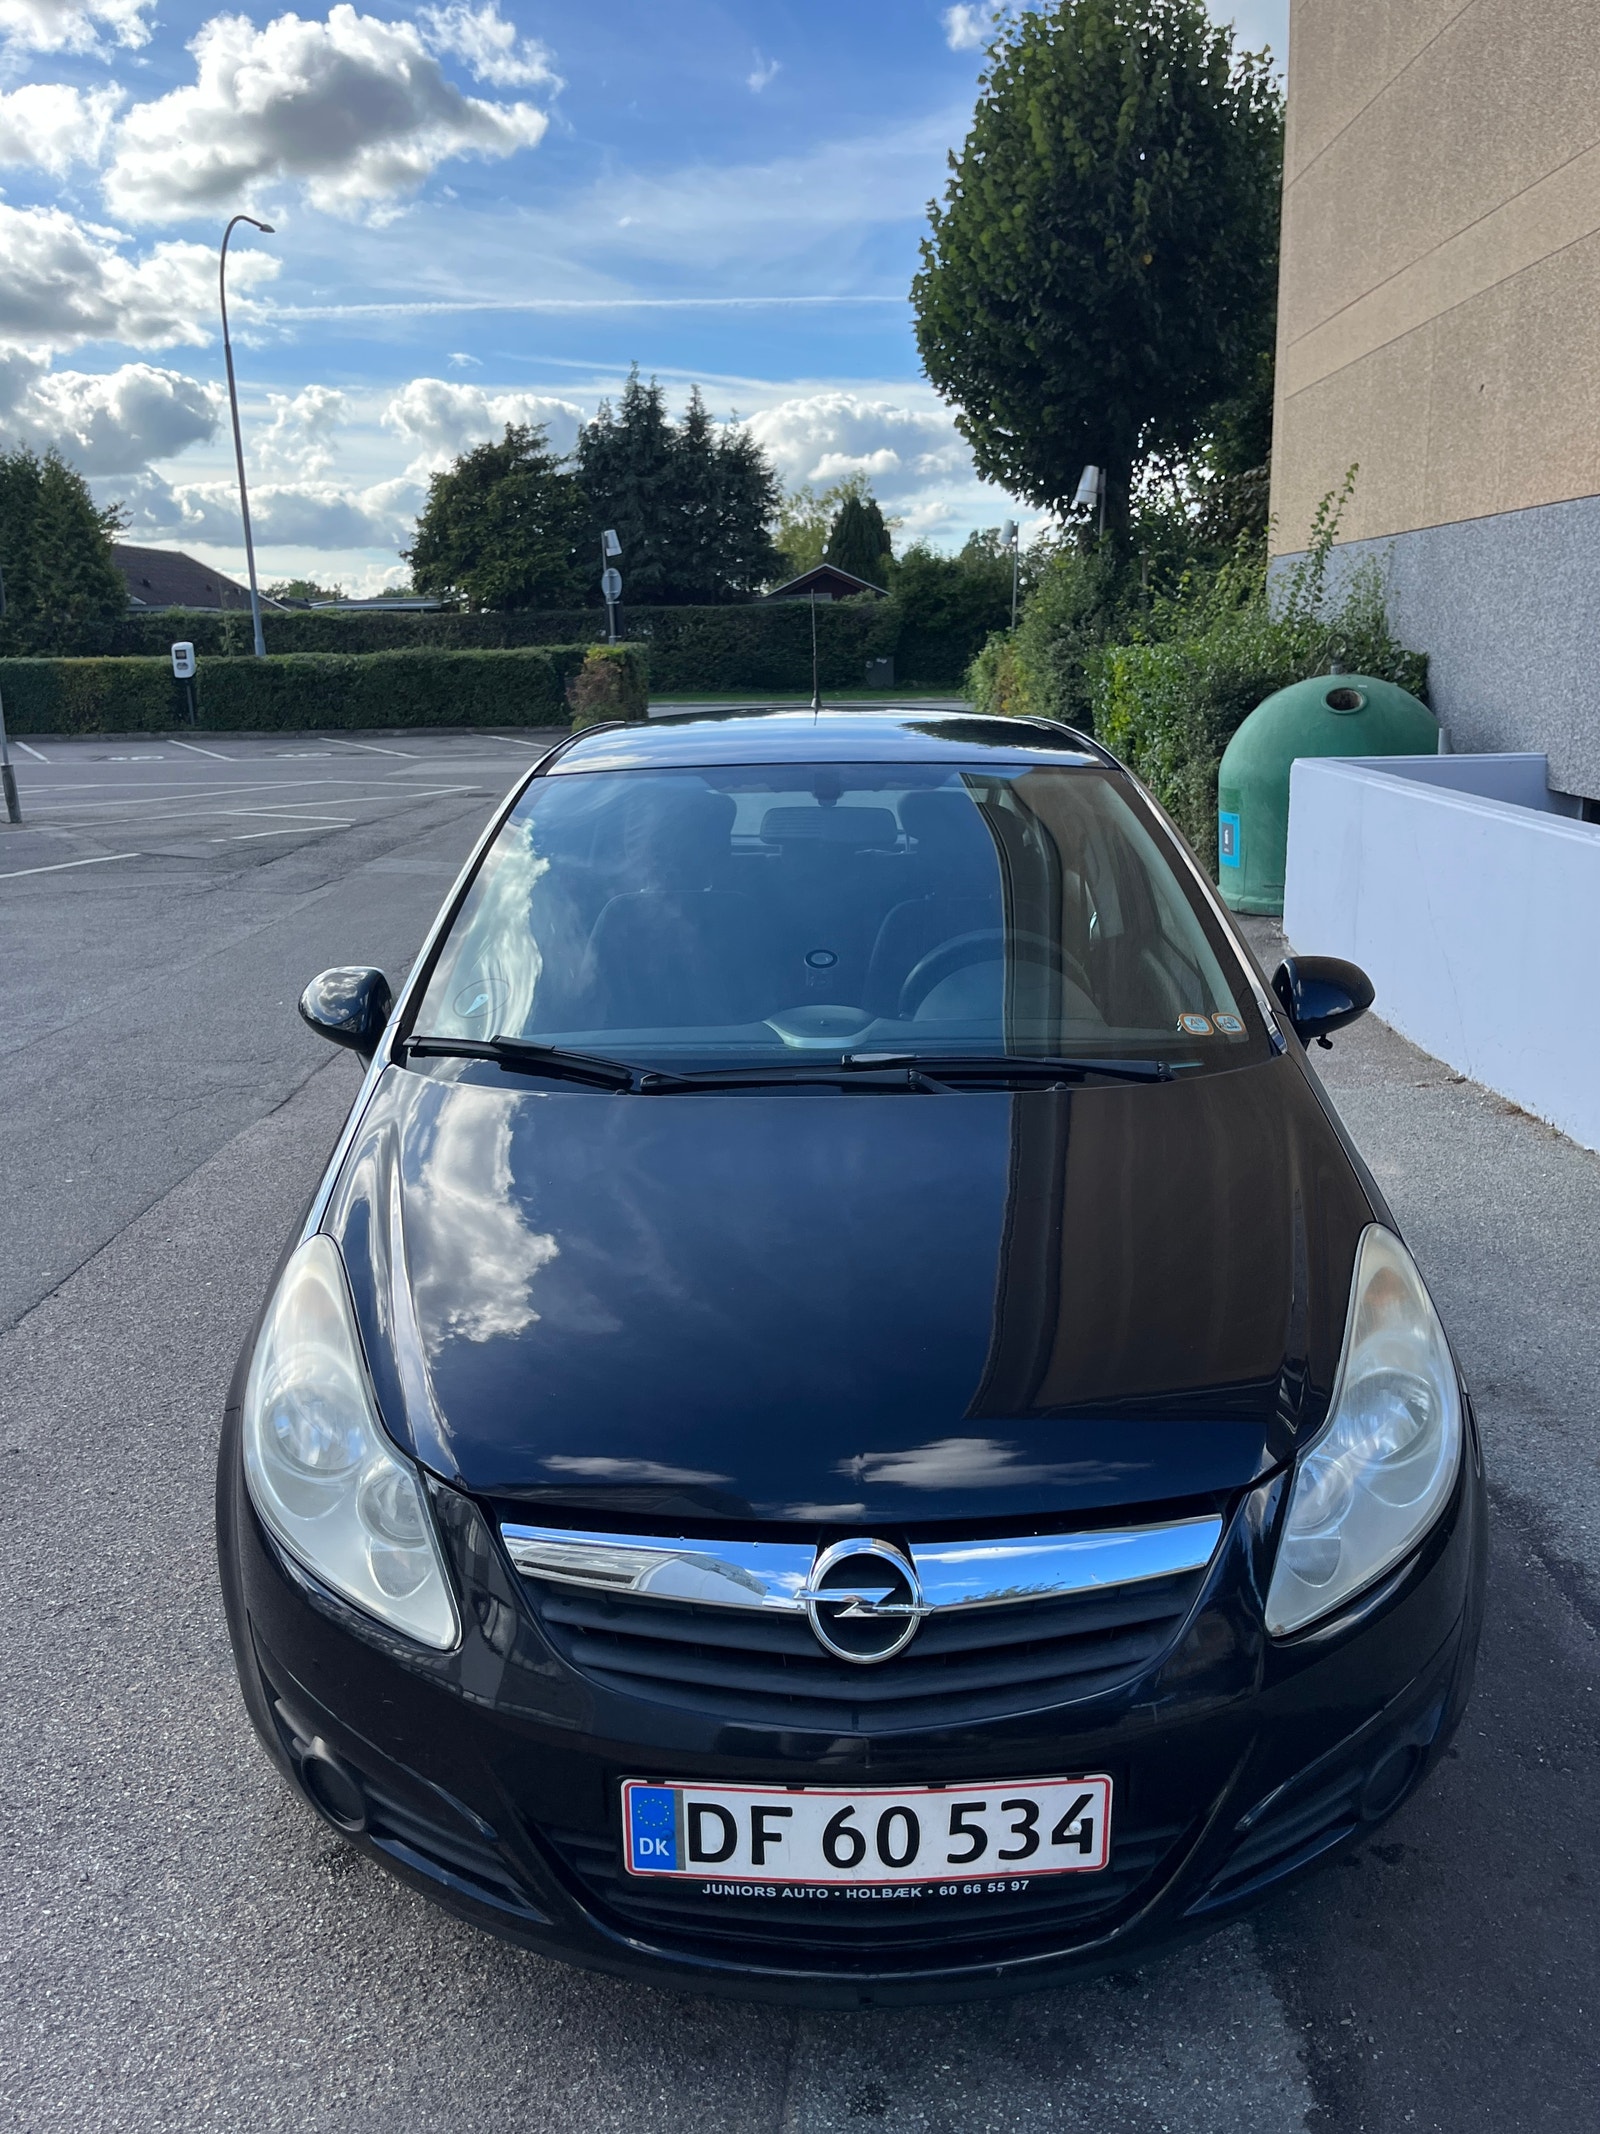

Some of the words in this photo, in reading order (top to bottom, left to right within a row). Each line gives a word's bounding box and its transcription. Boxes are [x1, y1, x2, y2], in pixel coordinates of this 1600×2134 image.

[687, 1802, 793, 1865] DF
[822, 1804, 920, 1869] 60
[947, 1793, 1094, 1864] 534
[639, 1837, 670, 1857] DK
[702, 1883, 777, 1897] JUNIORS
[781, 1887, 829, 1899] AUTO
[846, 1887, 922, 1899] HOLBÆK
[939, 1885, 958, 1896] 60
[963, 1883, 982, 1894] 66
[987, 1881, 1006, 1893] 55
[1011, 1880, 1030, 1891] 97
